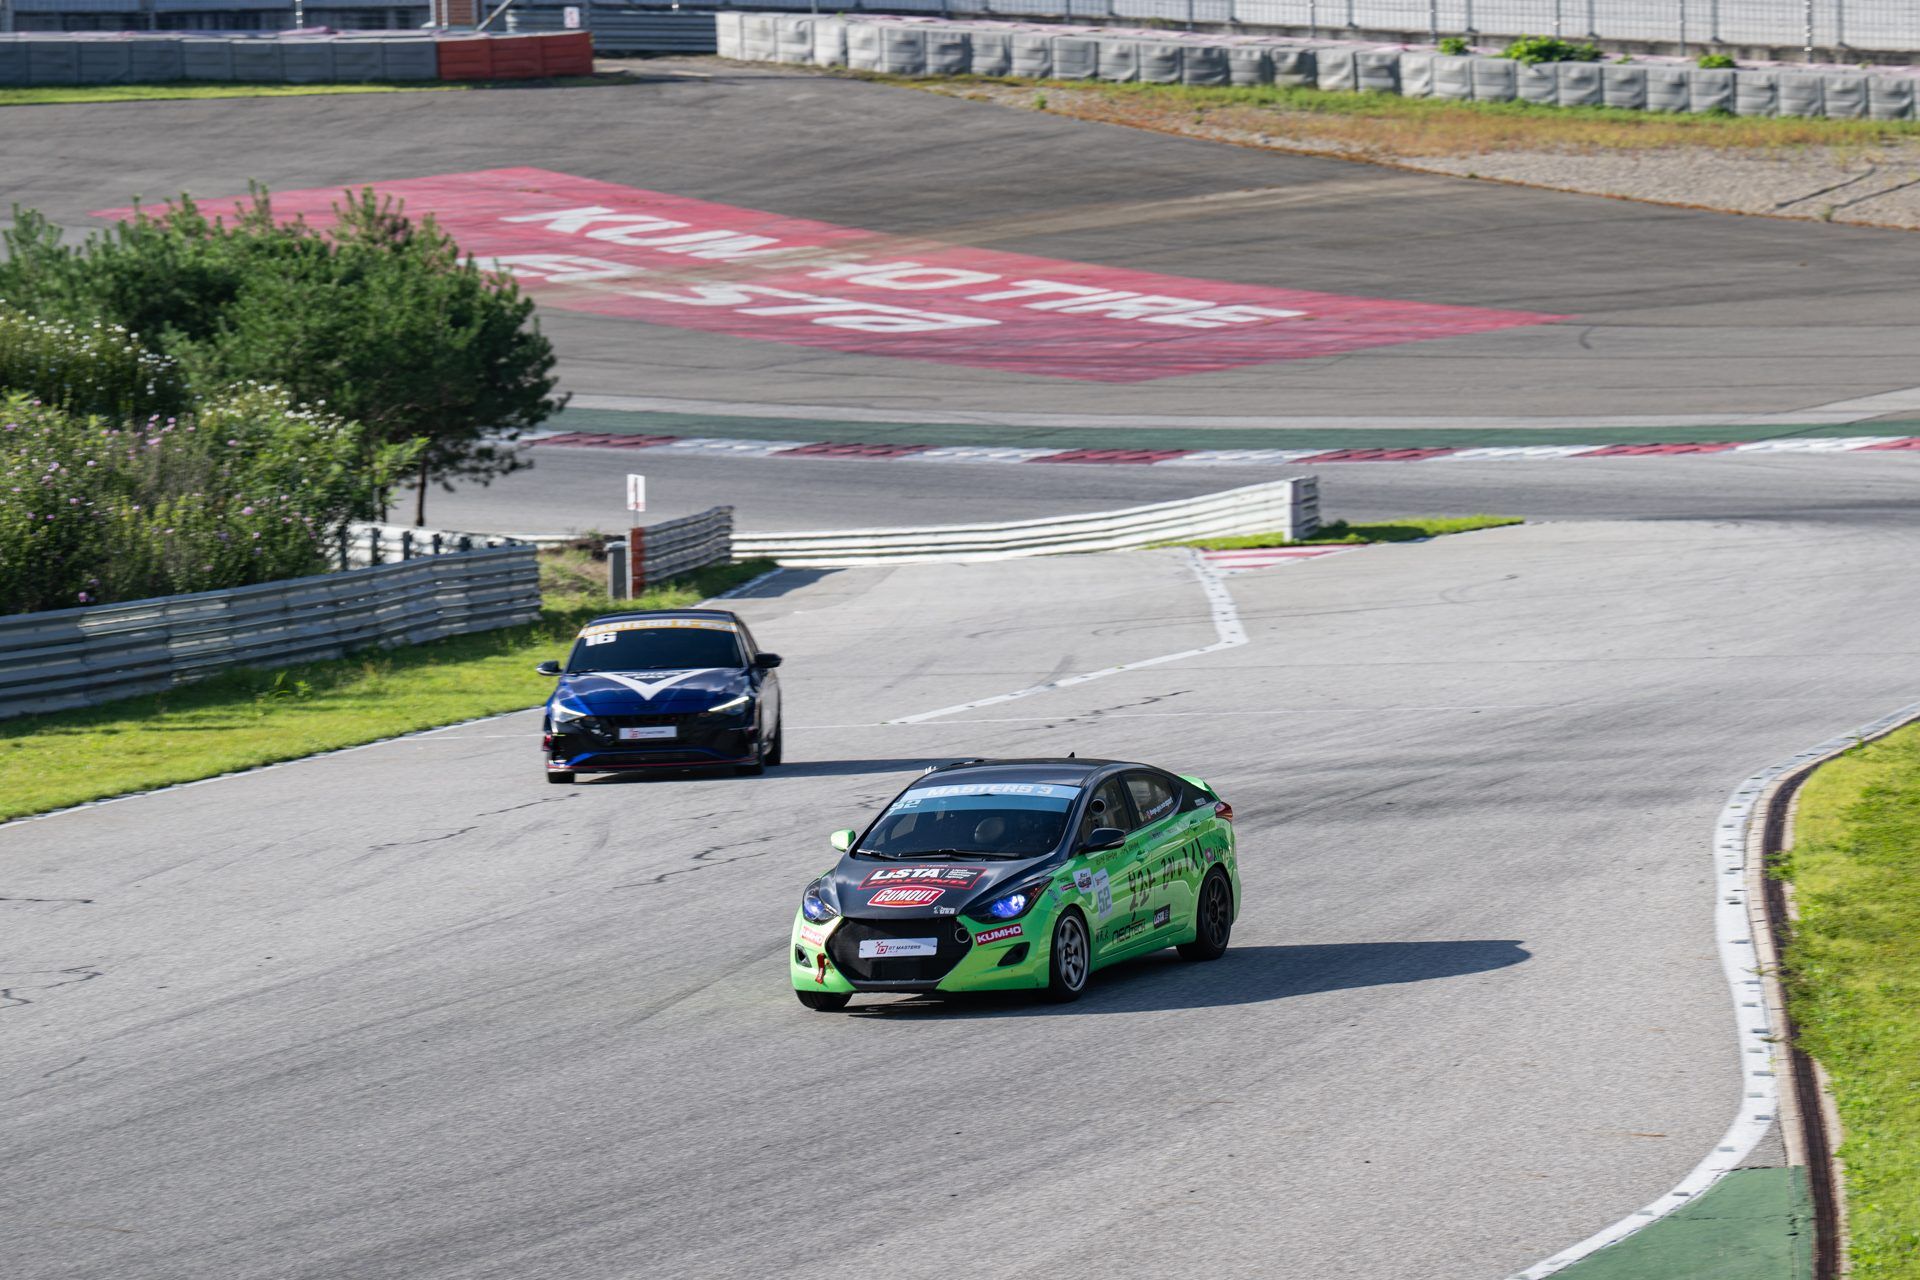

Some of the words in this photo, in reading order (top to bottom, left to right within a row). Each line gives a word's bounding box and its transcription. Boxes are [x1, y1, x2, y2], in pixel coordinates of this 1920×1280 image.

[500, 206, 1002, 290] KUMHO
[965, 279, 1308, 328] TIRE
[584, 632, 617, 646] 16
[926, 784, 1031, 796] MASTERS
[1098, 886, 1111, 913] 52
[976, 925, 1021, 943] KUMHO
